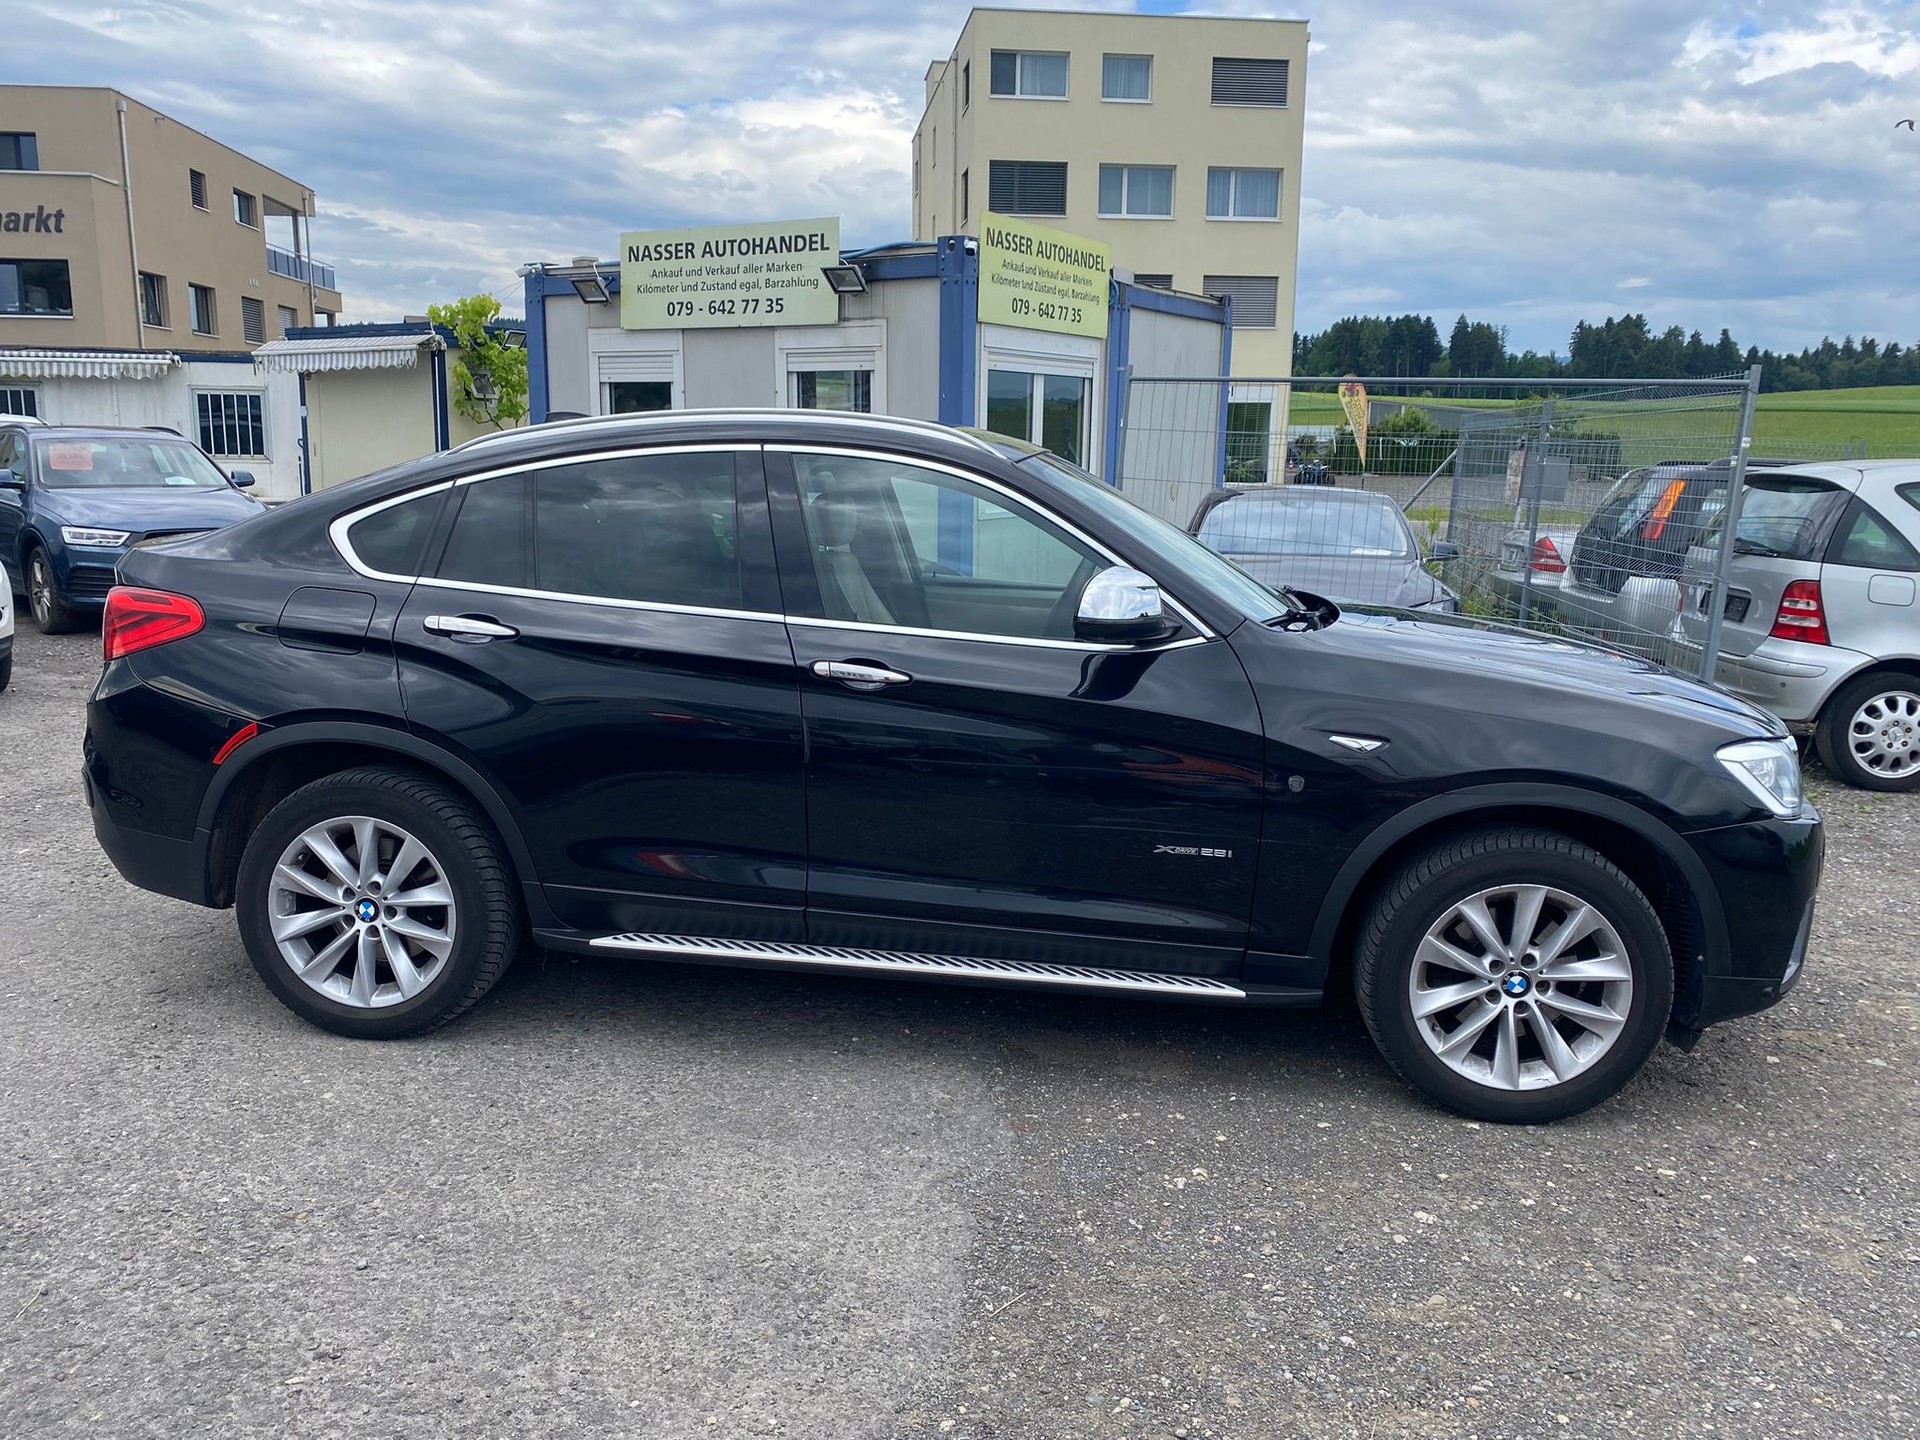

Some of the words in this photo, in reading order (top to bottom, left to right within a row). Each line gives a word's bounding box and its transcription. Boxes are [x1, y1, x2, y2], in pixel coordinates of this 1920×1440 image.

[0, 204, 65, 233] arkt
[628, 241, 696, 263] NASSER
[701, 232, 831, 259] AUTOHANDEL
[986, 227, 1033, 256] NASSER
[1036, 240, 1106, 273] AUTOHANDEL
[651, 267, 683, 279] Ankauf
[685, 267, 703, 277] und
[705, 263, 741, 276] Verkauf
[743, 263, 764, 274] aller
[766, 261, 803, 273] Marken
[1002, 259, 1025, 273] Ankauf
[1026, 265, 1037, 276] und
[1038, 267, 1060, 281] Verkauf
[1060, 273, 1072, 282] aller
[1072, 274, 1093, 287] Marken
[637, 284, 679, 294] Kilometer
[681, 282, 699, 292] und
[701, 279, 737, 292] Zustand
[740, 279, 762, 292] egal,
[765, 277, 819, 290] Barzahlung
[991, 273, 1021, 288] Kilometer
[1022, 279, 1034, 291] und
[1035, 281, 1057, 296] Zustand
[1071, 289, 1101, 306] Barzahlung
[667, 301, 694, 317] 079
[708, 299, 736, 315] 642
[741, 298, 760, 314] 77
[765, 298, 784, 314] 35
[1011, 297, 1030, 316] 079
[1038, 302, 1055, 320] 642
[1058, 306, 1069, 323] 77
[1071, 308, 1082, 324] 35
